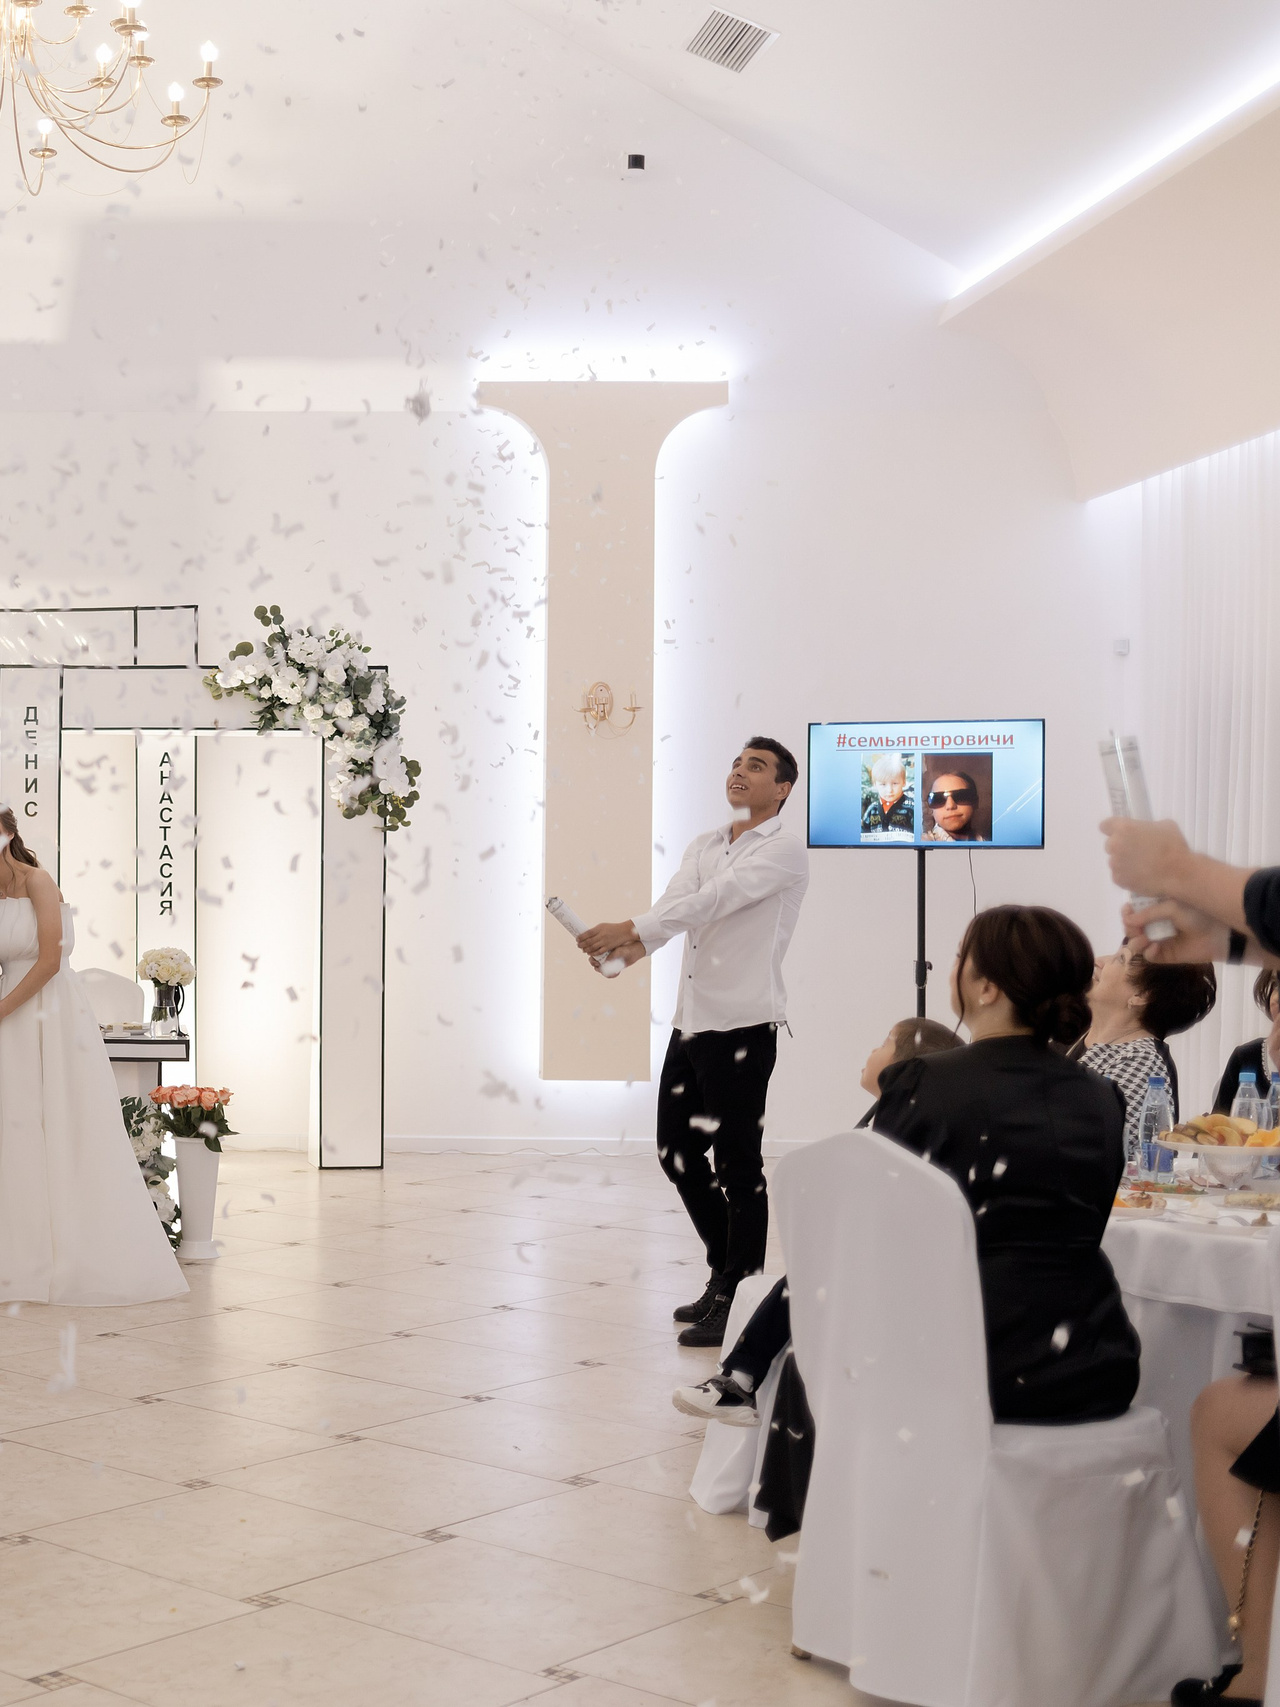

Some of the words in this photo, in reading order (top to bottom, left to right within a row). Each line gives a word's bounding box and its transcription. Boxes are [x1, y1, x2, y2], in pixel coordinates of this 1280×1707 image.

[23, 706, 39, 817] ДЕНИС
[836, 733, 1014, 749] #семьяпетровичи
[159, 751, 174, 916] АНАСТАСИЯ
